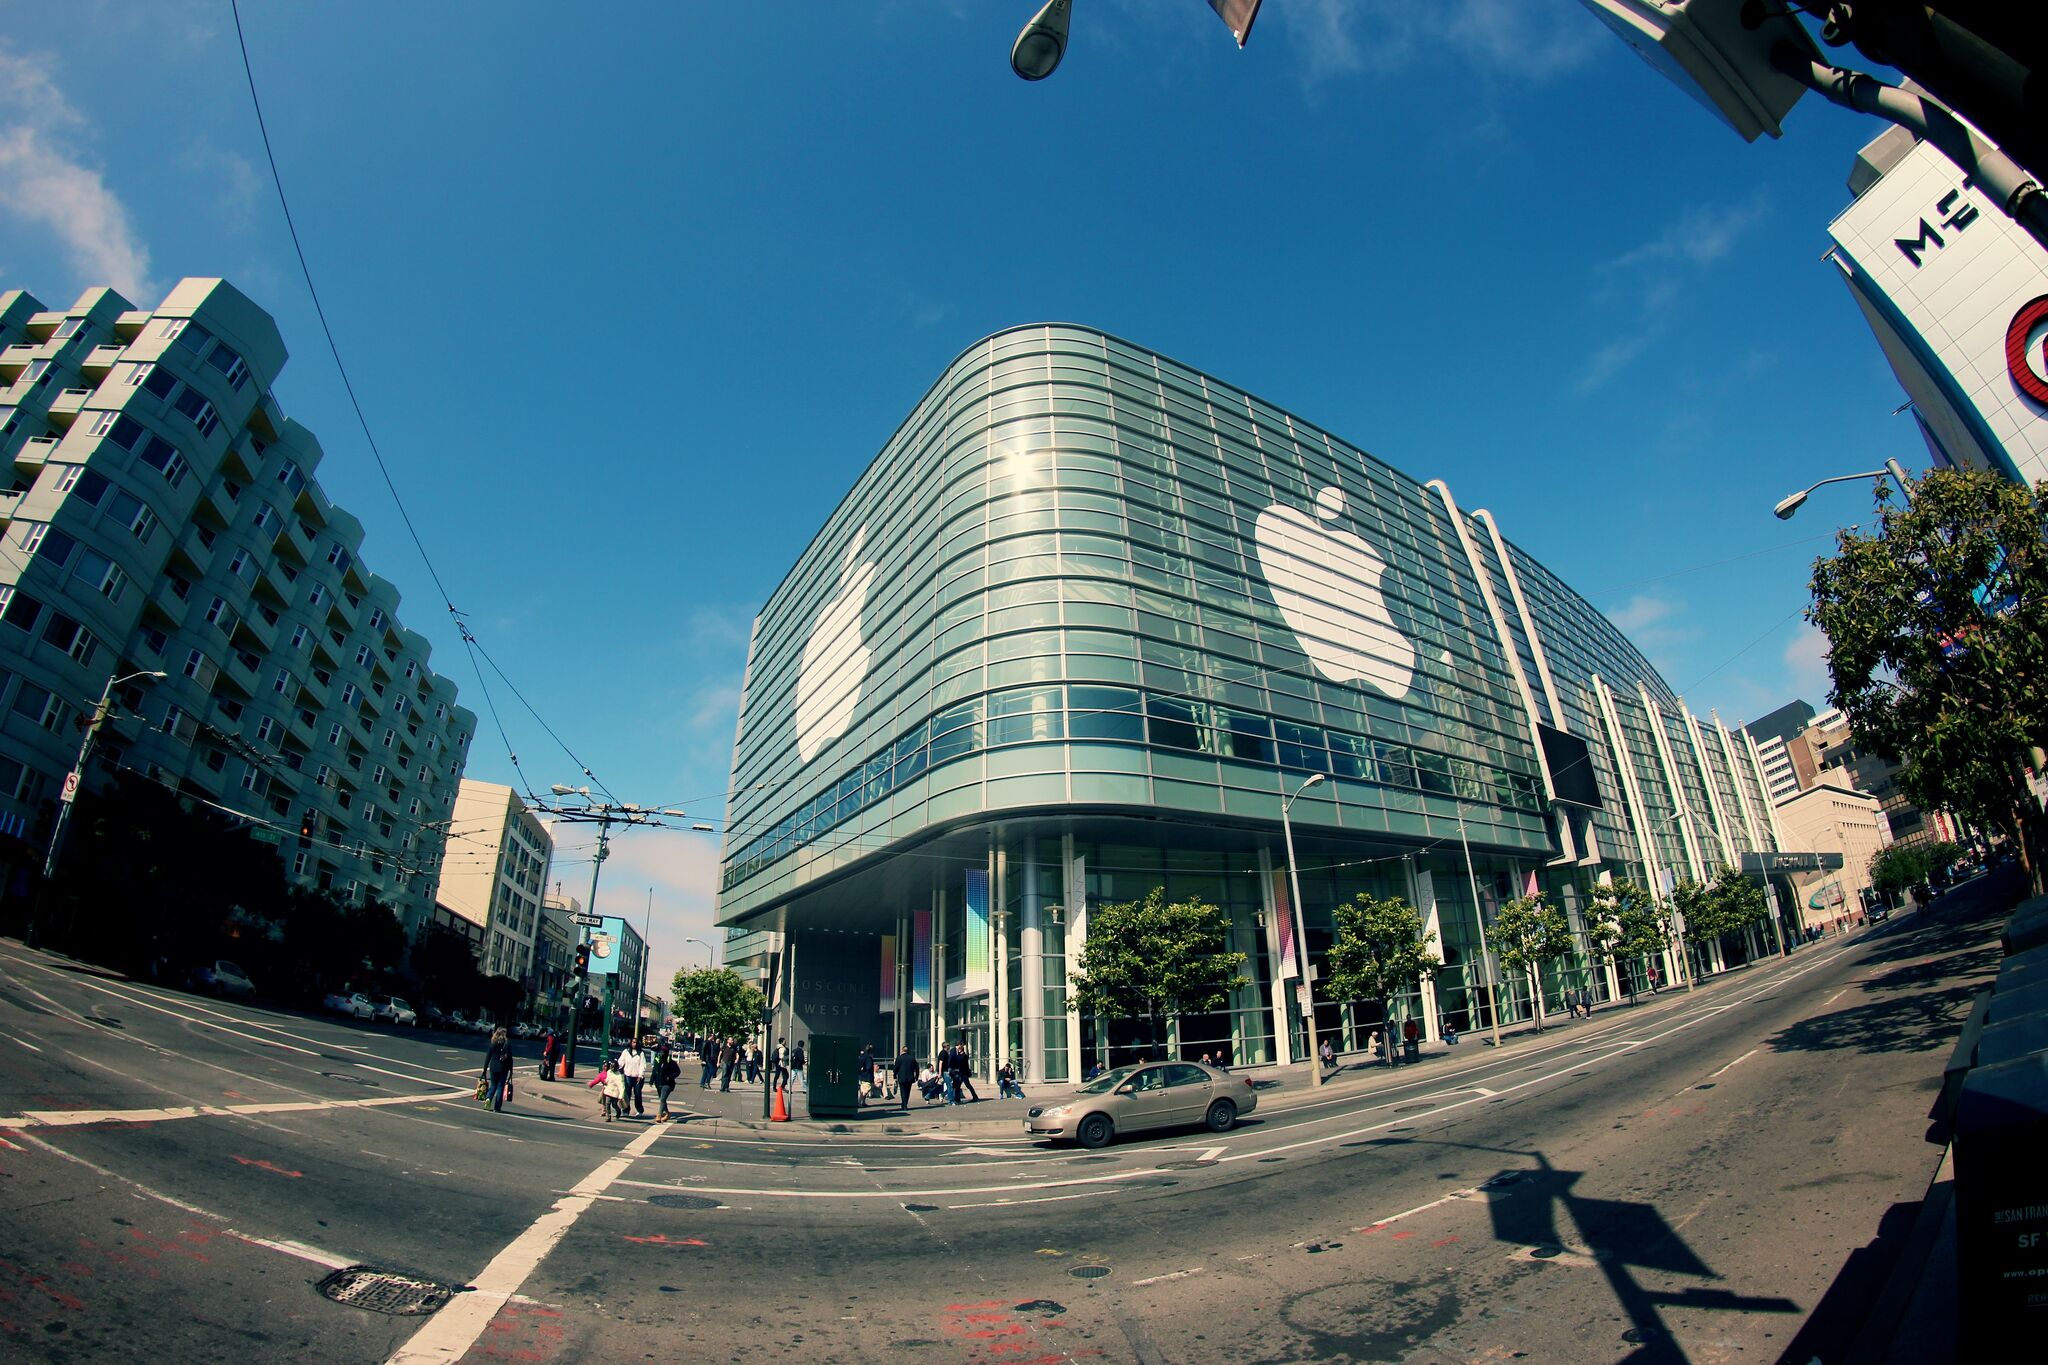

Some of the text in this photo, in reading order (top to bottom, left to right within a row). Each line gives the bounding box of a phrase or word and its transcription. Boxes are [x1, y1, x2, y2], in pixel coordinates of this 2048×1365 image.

[1894, 176, 1981, 268] ME
[805, 1003, 851, 1016] WEST
[2004, 1207, 2023, 1223] SAN
[2017, 1232, 2041, 1249] SF
[2003, 1268, 2048, 1279] www.op
